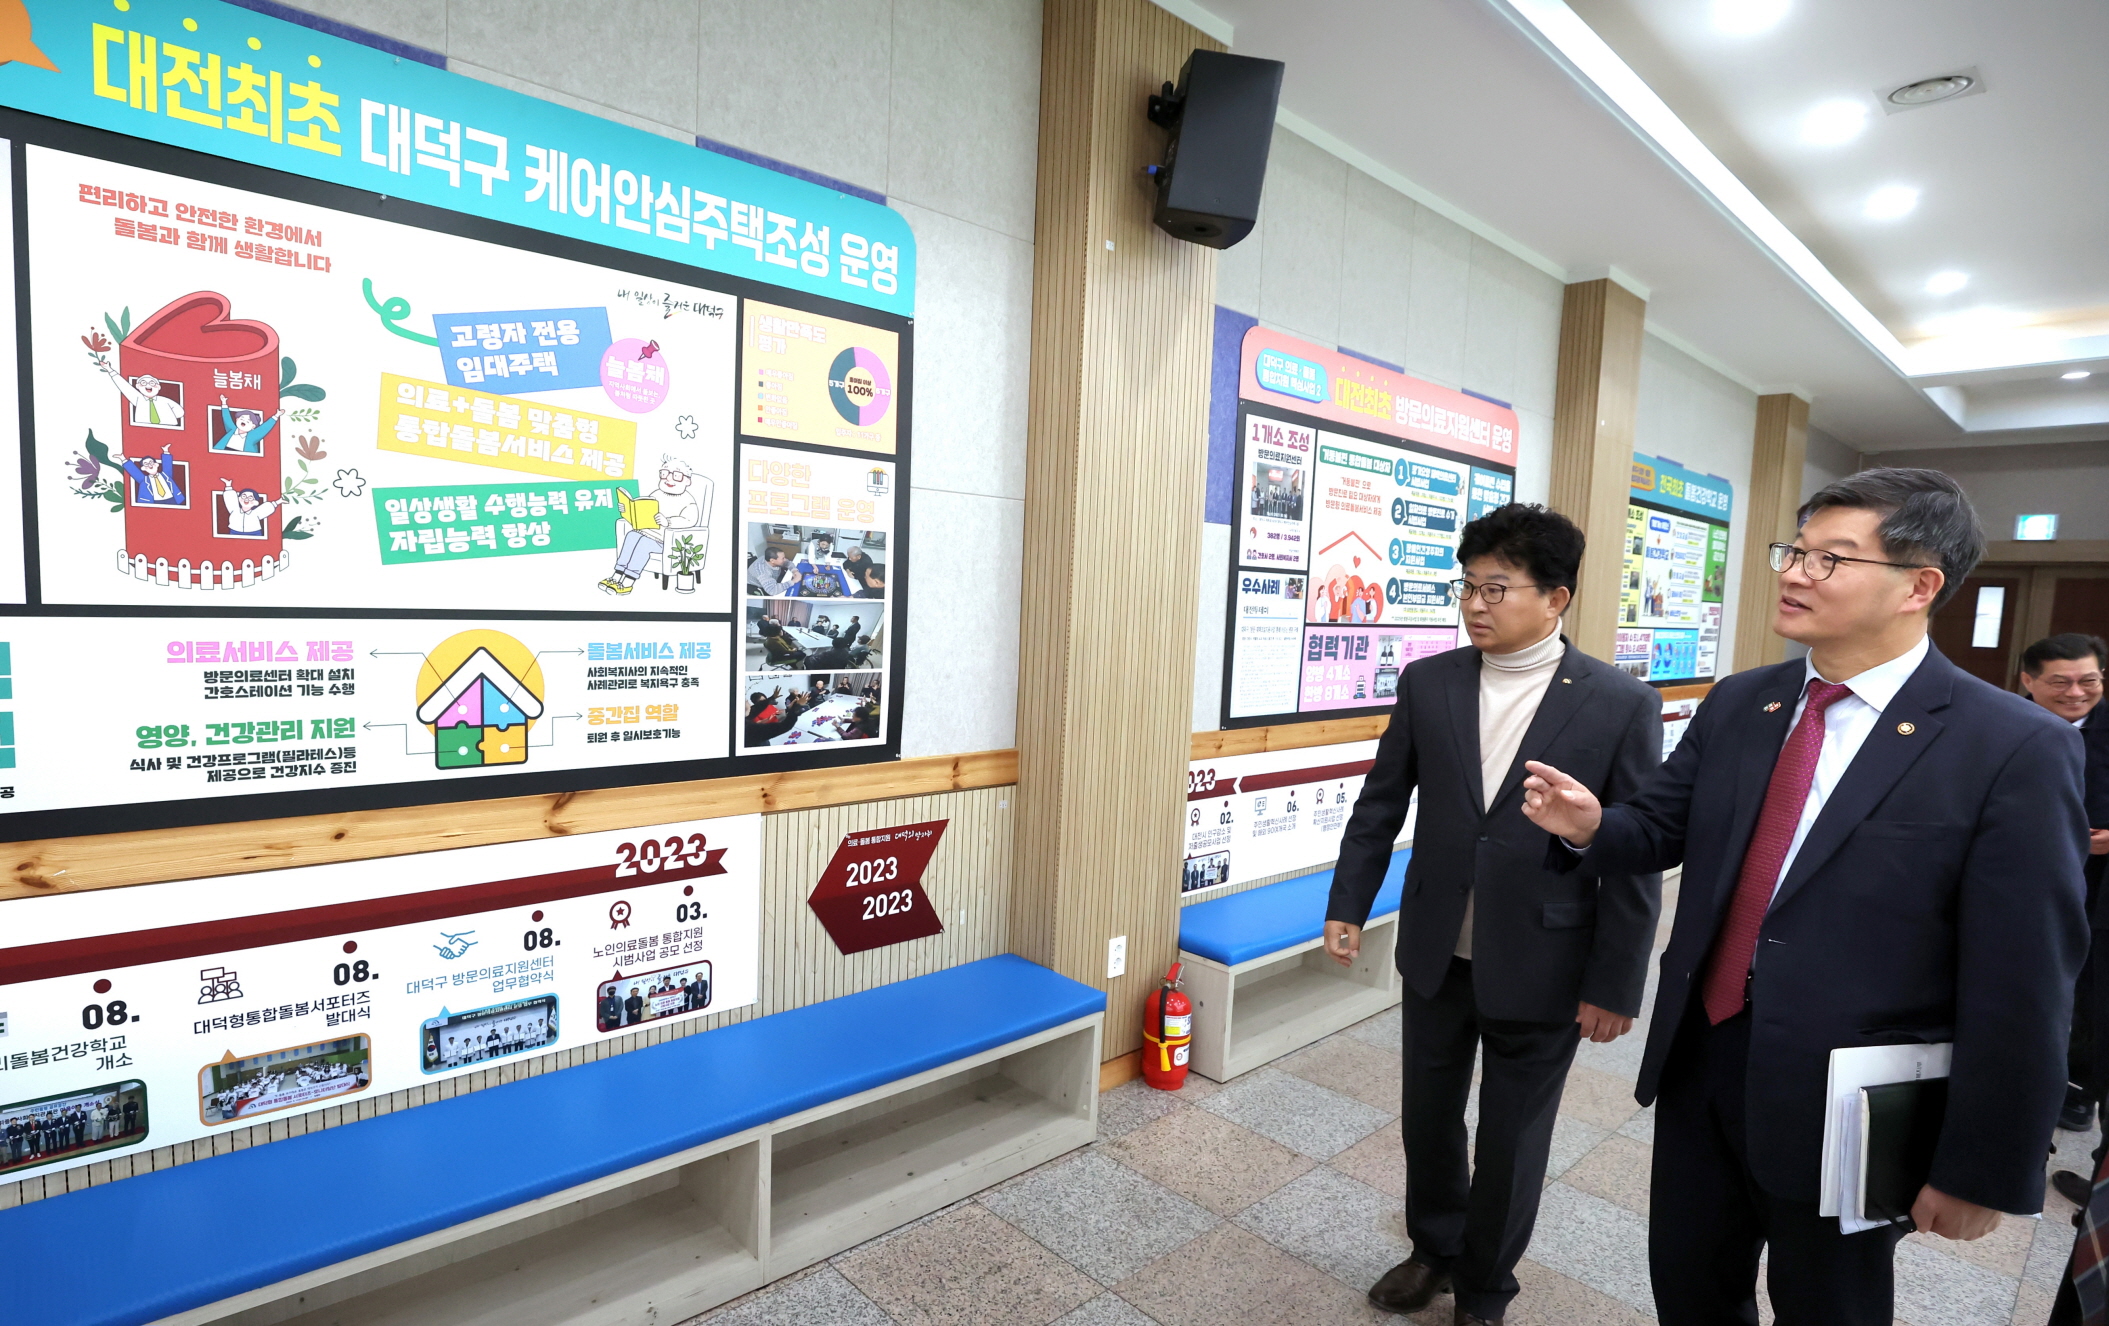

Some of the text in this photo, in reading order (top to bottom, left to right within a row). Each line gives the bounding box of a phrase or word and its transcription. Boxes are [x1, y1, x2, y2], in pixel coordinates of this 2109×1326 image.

[92, 22, 899, 296] 대전최초 대덕구 케어안심주택조성 운영
[79, 183, 322, 247] 편리하고 안전한 환경에서
[114, 217, 332, 273] 돌봄과 함께 생활합니다
[450, 319, 580, 350] 고령자 전용
[455, 351, 559, 383] 임대주택
[606, 356, 665, 386] 늘봄채
[1263, 354, 1284, 370] 대덕구
[213, 369, 261, 390] 늘봄채
[847, 384, 874, 398] 100%
[396, 382, 600, 444] 의료+돌봄 맞춤형
[1335, 377, 1513, 452] 대전최초 방문의료지원센터 운영
[394, 414, 627, 478] 통합돌봄서비스 제공
[1252, 423, 1309, 452] 1개소 조성
[748, 459, 811, 488] 다양한
[1398, 465, 1404, 480] 1
[384, 488, 613, 525] 일상생활 수행능력 유지
[748, 490, 875, 524] 프로그램 운영
[1395, 504, 1402, 519] 2
[388, 521, 552, 555] 자립능력 향상
[1392, 545, 1399, 559] 3
[1242, 578, 1280, 595] 우수사례
[1389, 584, 1396, 598] 4
[167, 640, 354, 663] 의료서비스 제공
[587, 642, 711, 660] 돌봄서비스 제공
[1308, 634, 1369, 661] 협력기관
[204, 668, 355, 683] 방문의료센터 확대 설치
[587, 665, 688, 677] 사회복지사의 지속적인
[1306, 664, 1350, 682] 양방 4개소
[204, 682, 355, 699] 간호스테이션 기능 수행
[587, 677, 700, 690] 사례관리로 복지욕구 충족
[587, 704, 679, 725] 중간집 역할
[136, 717, 356, 749] 영양, 건강관리 지원
[587, 728, 681, 743] 퇴원 후 일시보호기능
[130, 747, 356, 771] 식사 및 건강프로그램(필라테스)등
[207, 760, 356, 782] 제공으로 건강지수 증진
[1287, 800, 1299, 813] 06.
[1336, 792, 1347, 804] 05.
[1220, 811, 1234, 825] 02.
[615, 833, 707, 878] 2023
[846, 857, 898, 887] 2023
[676, 901, 708, 923] 03.
[862, 889, 913, 920] 2023
[523, 927, 561, 951] 08.
[592, 926, 704, 959] 노인의료돌봄 통합지원
[613, 941, 704, 967] 시범사업 공모 선정
[333, 959, 380, 986] 08.
[406, 955, 555, 995] 대덕구 방문의료지원센터
[492, 970, 554, 993] 업무협약식
[82, 1000, 140, 1030] 08.
[193, 990, 371, 1035] 대덕형통합돌봄서포터즈
[325, 1006, 371, 1027] 발대식
[96, 1053, 133, 1071] 개소
